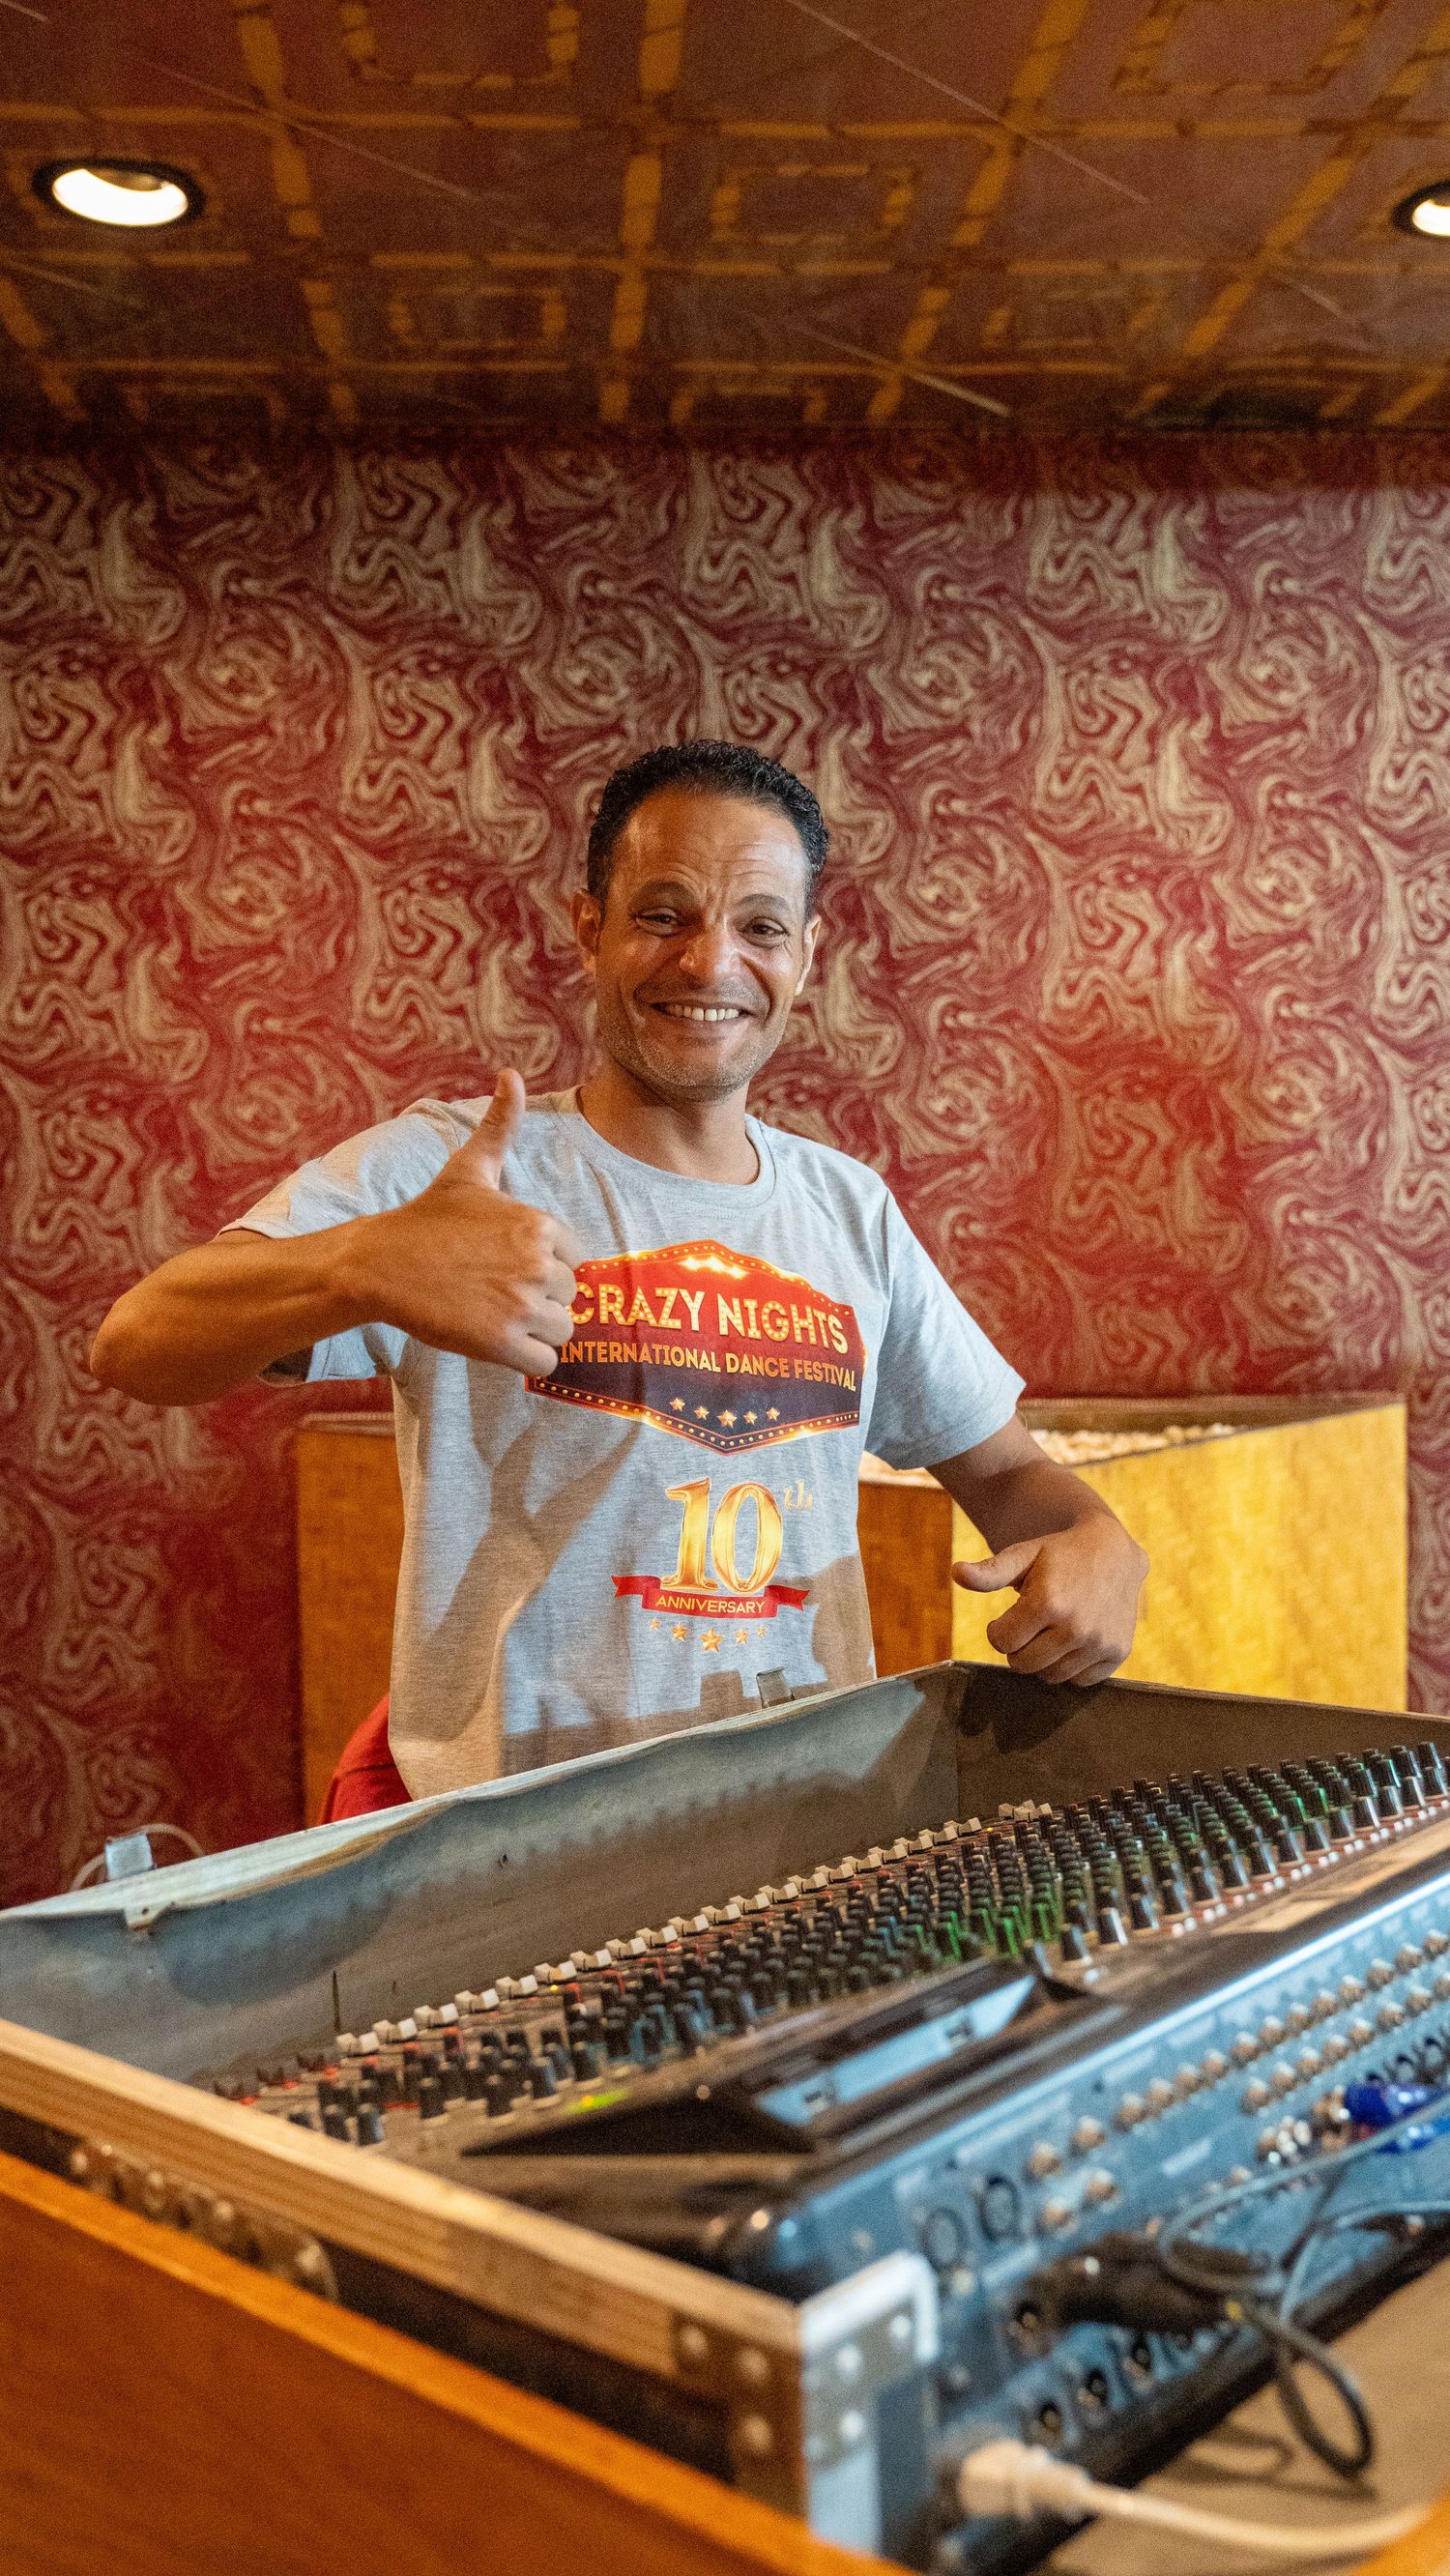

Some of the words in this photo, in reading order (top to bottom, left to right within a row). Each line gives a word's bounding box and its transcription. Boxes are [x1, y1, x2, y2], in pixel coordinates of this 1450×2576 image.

[566, 1282, 705, 1331] CRAZY
[716, 1293, 849, 1354] NIGHTS
[561, 1341, 721, 1373] INTERNATIONAL
[725, 1352, 790, 1378] DANCE
[794, 1358, 856, 1392] FESTIVAL
[655, 1595, 766, 1613] ANNIVERSARY
